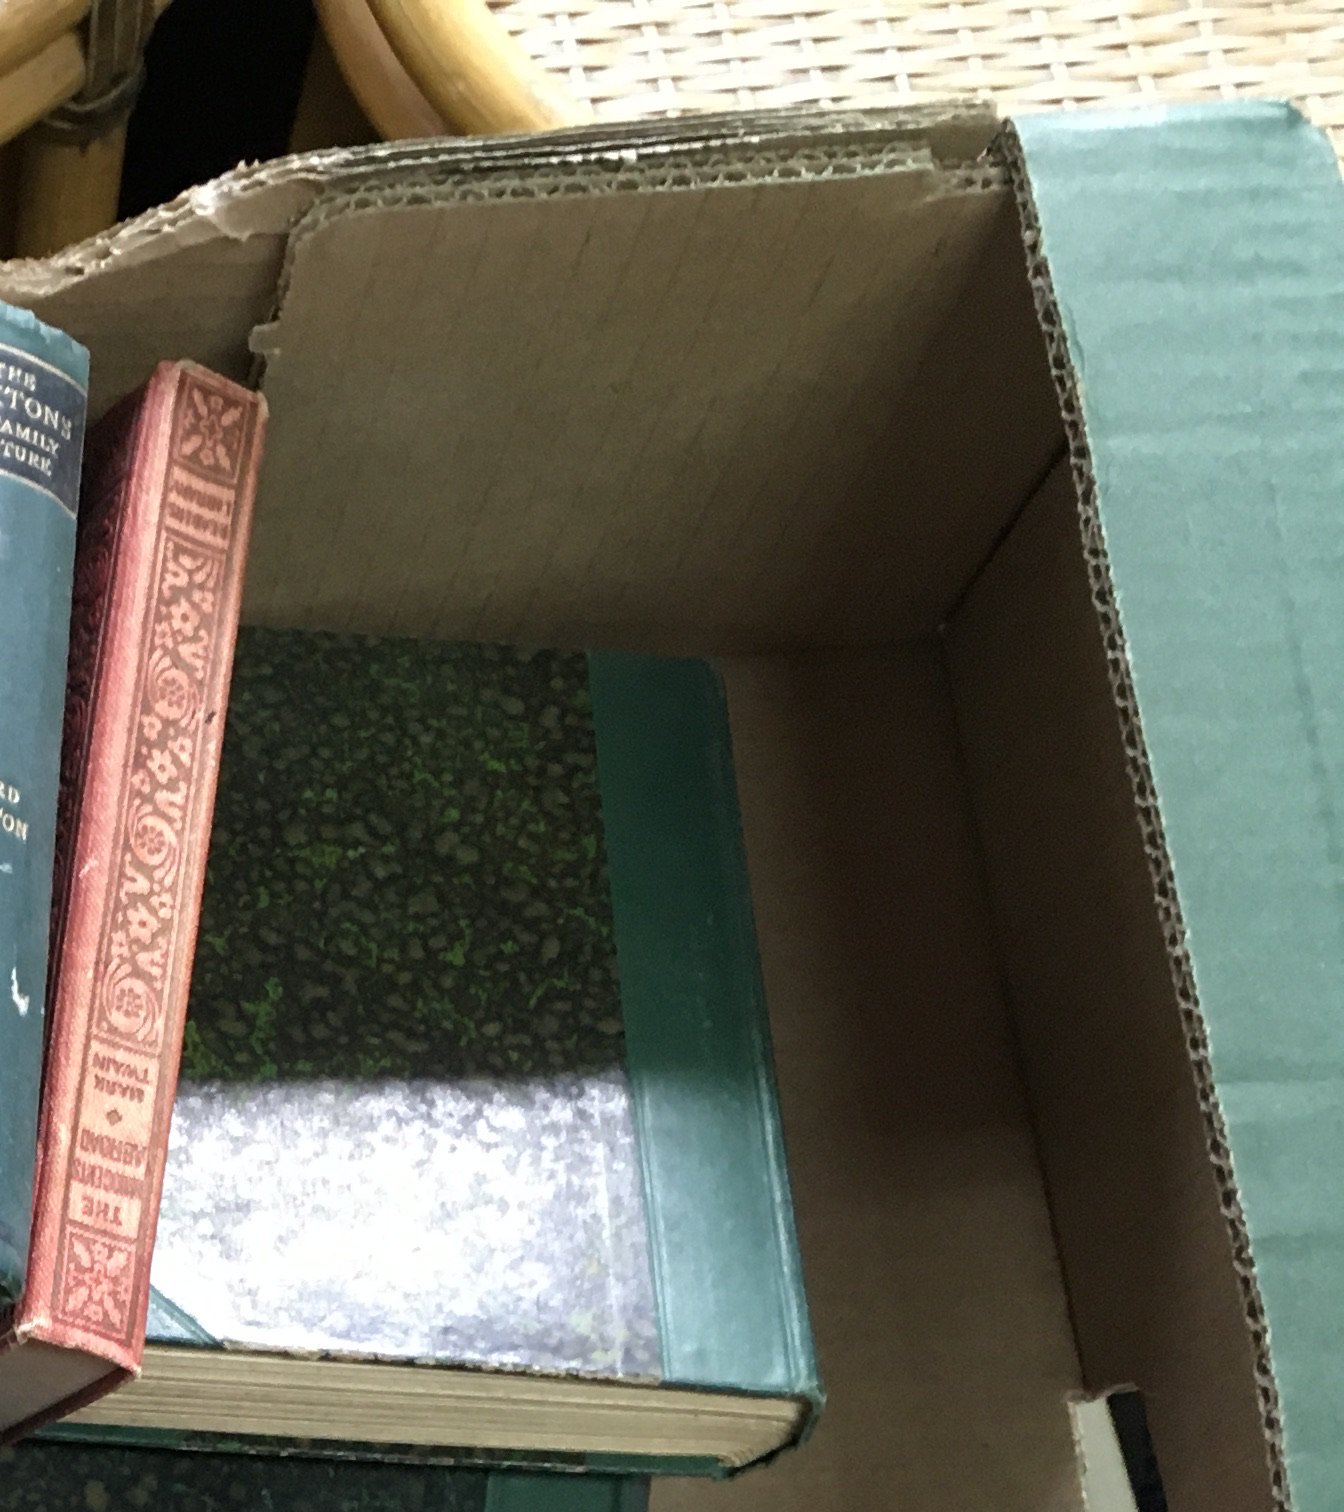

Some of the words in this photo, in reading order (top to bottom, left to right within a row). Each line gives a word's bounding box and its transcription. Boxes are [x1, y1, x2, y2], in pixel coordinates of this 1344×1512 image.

[92, 1053, 150, 1084] TWAIN
[93, 1072, 146, 1104] MARK
[80, 1128, 149, 1168] ABROAD
[82, 1195, 124, 1227] THE
